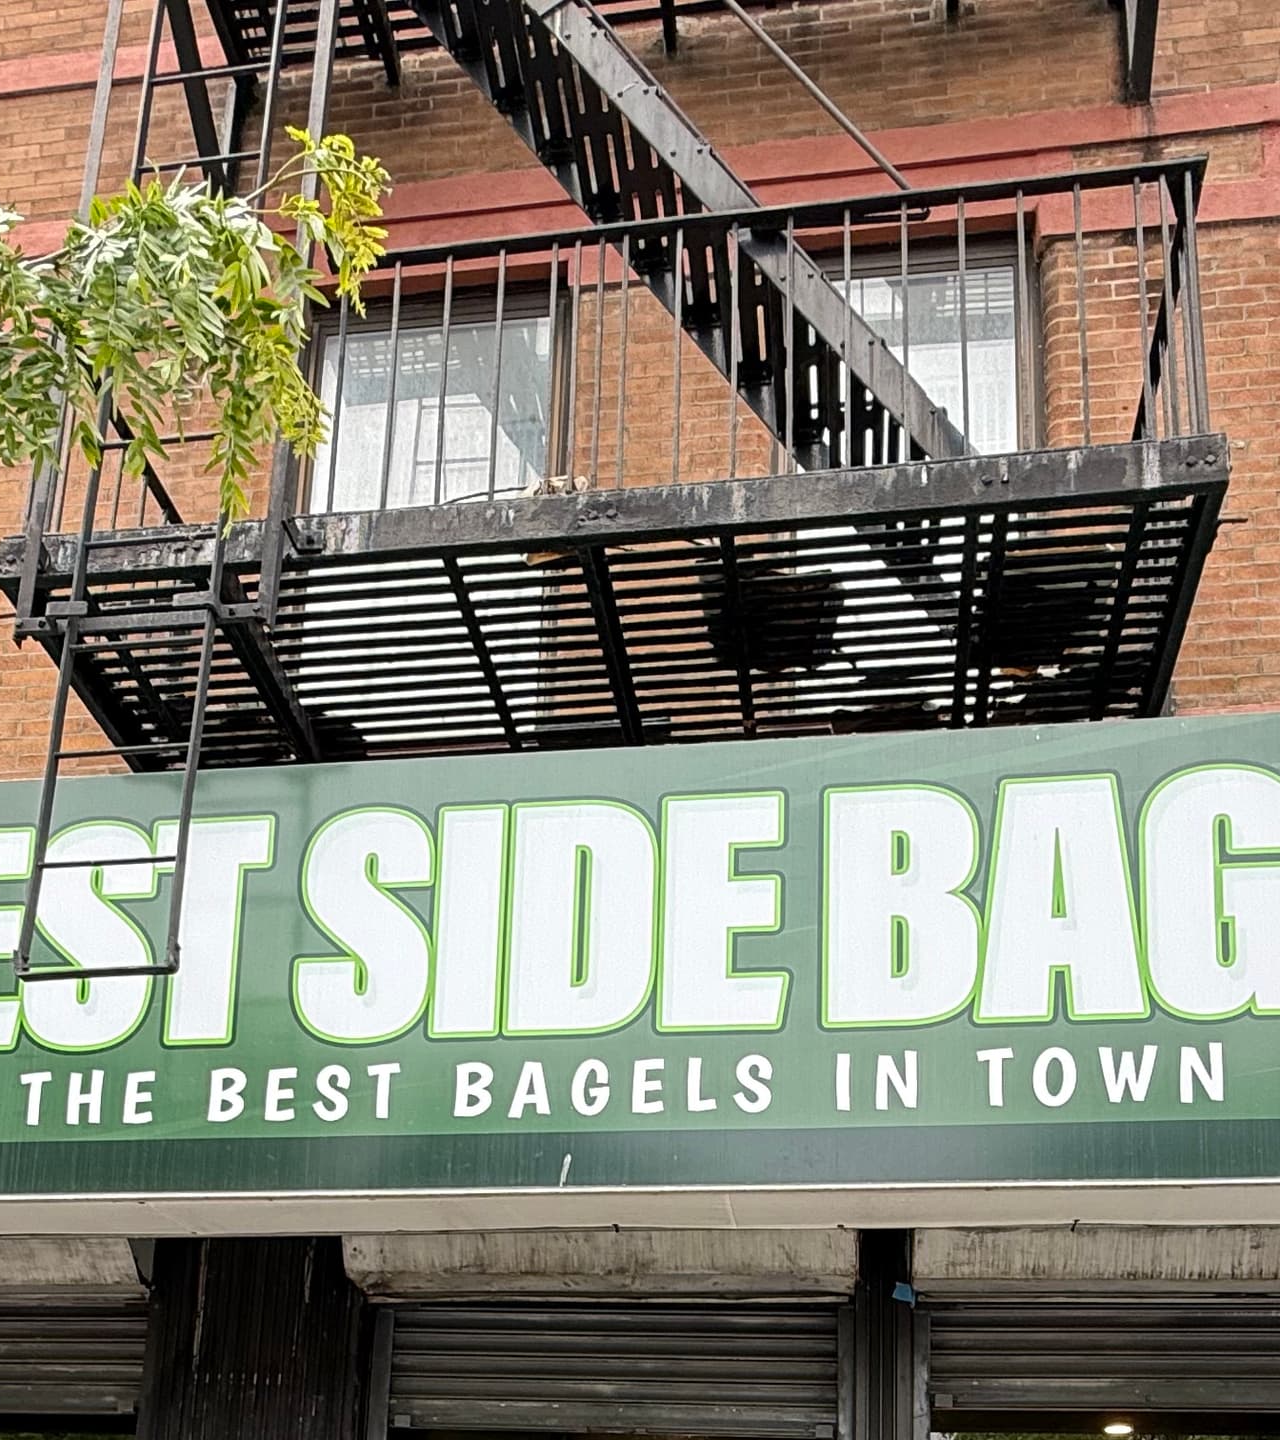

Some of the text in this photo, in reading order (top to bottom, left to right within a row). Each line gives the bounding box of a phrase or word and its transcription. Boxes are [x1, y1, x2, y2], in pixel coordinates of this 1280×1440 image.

[293, 789, 790, 1045] SIDE
[20, 1042, 1225, 1126] THE BEST BAGELS IN TOWN
